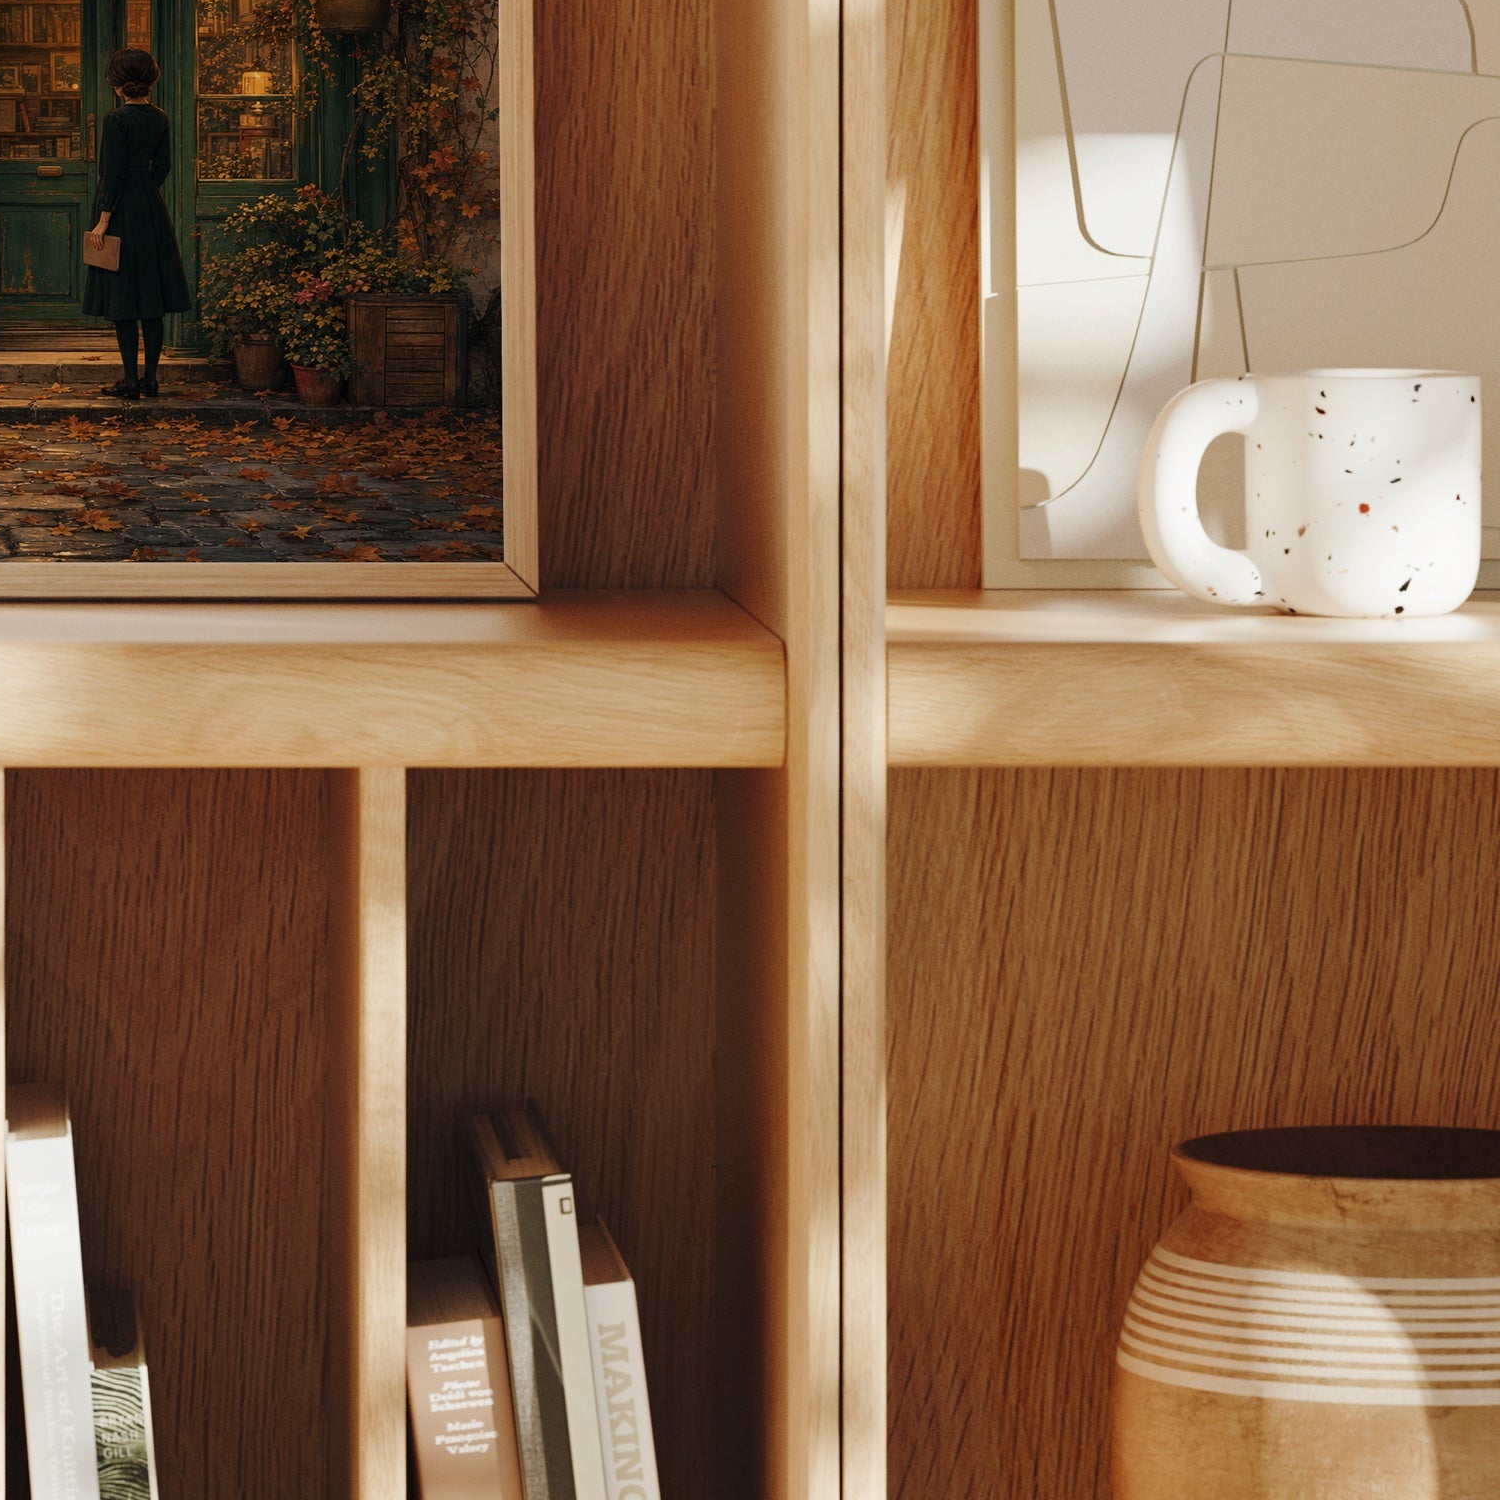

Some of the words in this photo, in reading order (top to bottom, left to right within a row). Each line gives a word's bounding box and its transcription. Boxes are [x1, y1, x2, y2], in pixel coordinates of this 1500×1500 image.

[428, 1336, 468, 1350] Edited
[429, 1347, 485, 1361] Angelica
[430, 1360, 485, 1373] Taschen
[468, 1388, 493, 1398] von
[446, 1419, 484, 1432] Marie
[103, 1446, 133, 1459] GILL
